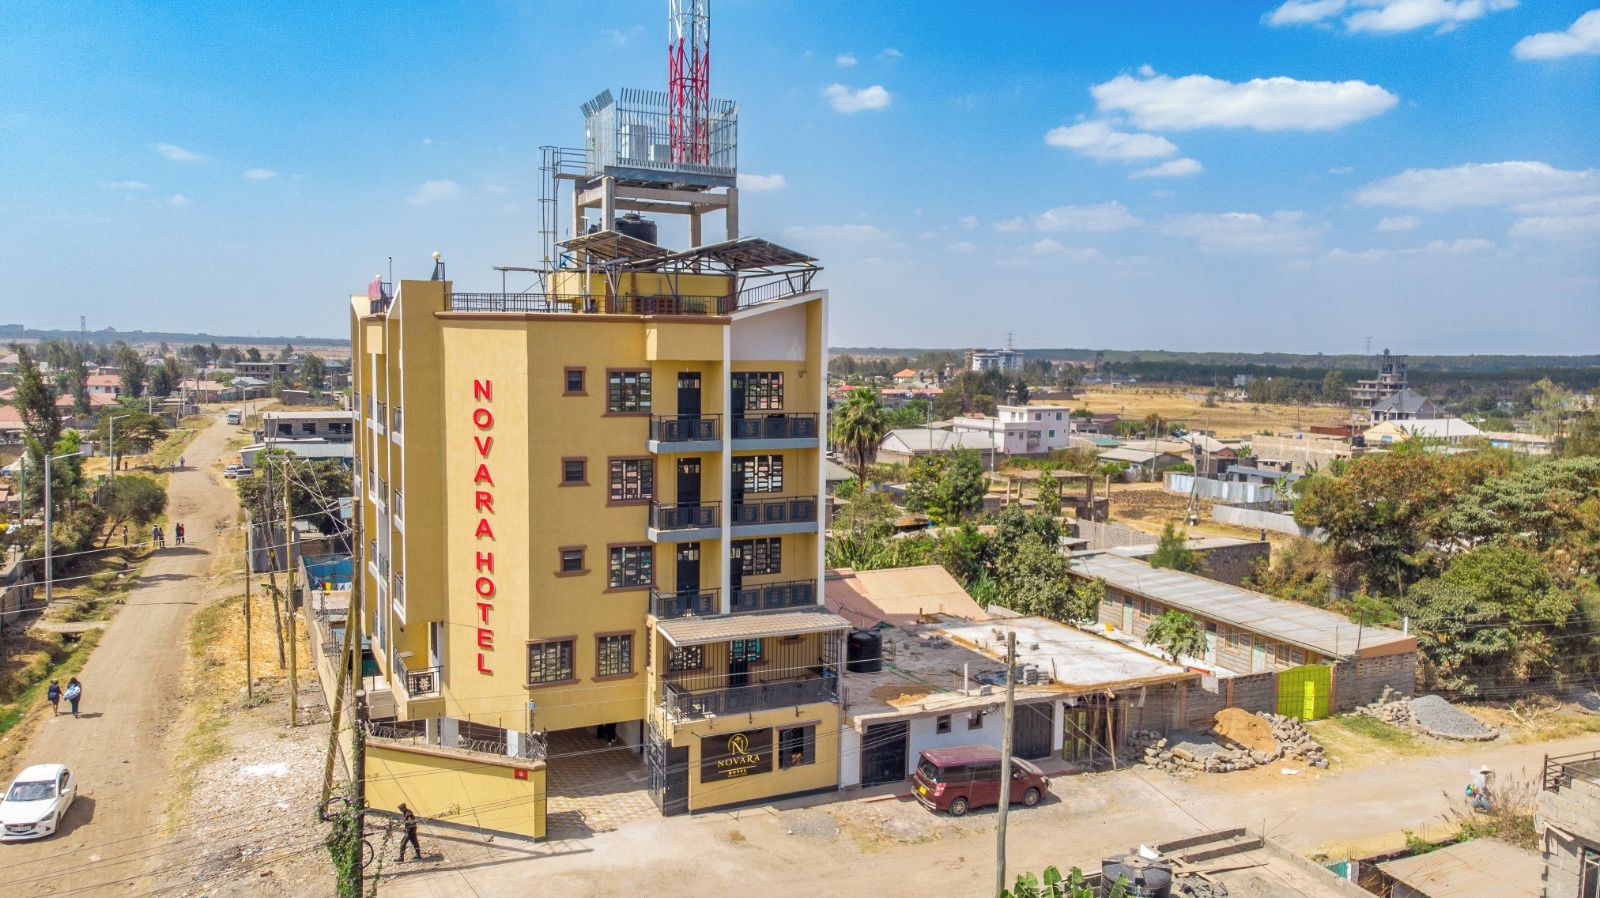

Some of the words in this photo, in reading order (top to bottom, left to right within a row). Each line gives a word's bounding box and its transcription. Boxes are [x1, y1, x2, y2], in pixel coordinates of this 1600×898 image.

[473, 379, 494, 539] NOVARA
[475, 551, 495, 673] HOTEL
[717, 754, 760, 768] NOVARA
